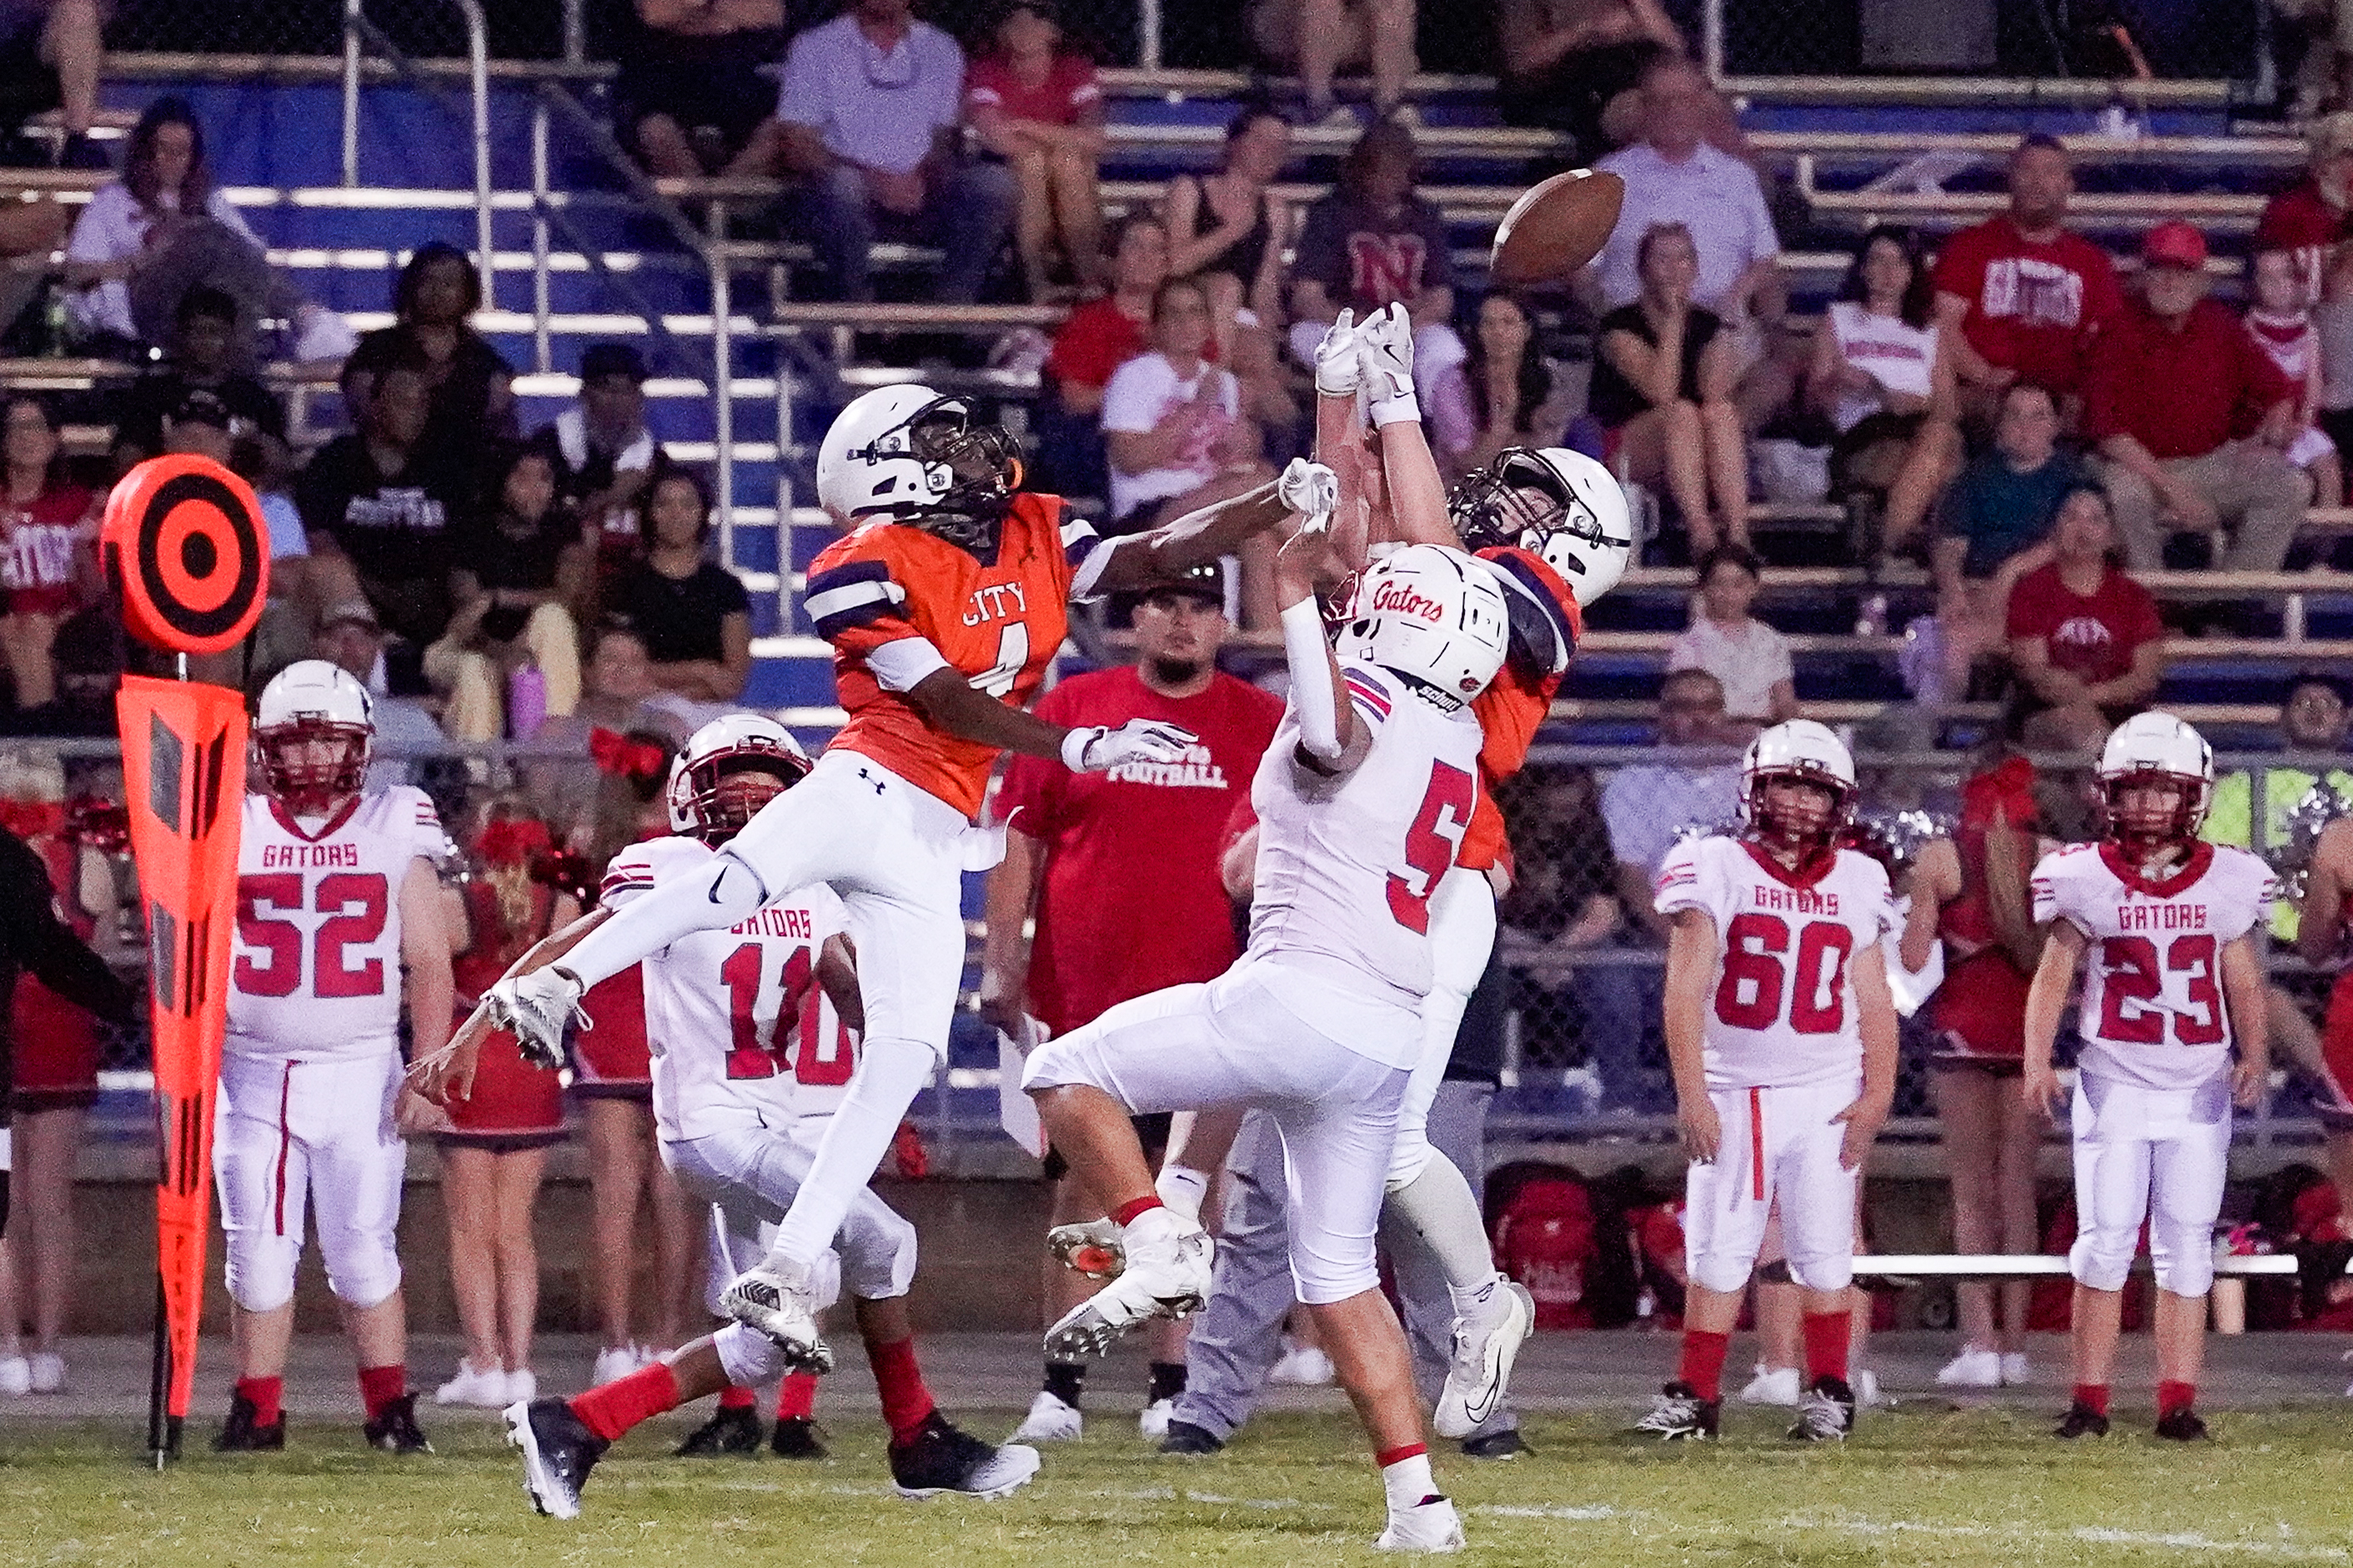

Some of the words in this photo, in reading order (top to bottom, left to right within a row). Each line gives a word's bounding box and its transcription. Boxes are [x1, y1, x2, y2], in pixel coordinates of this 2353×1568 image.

[1347, 232, 1427, 303] N
[1373, 579, 1442, 622] Gators
[1418, 685, 1460, 711] schutt
[1106, 762, 1228, 789] FOOTBALL
[263, 844, 358, 867] GATORS
[1386, 757, 1473, 937] 5
[1755, 885, 1839, 916] GATORS
[2118, 904, 2207, 929] GATORS
[233, 872, 389, 998] 52
[1714, 912, 1854, 1034] 60
[2097, 934, 2225, 1046] 23
